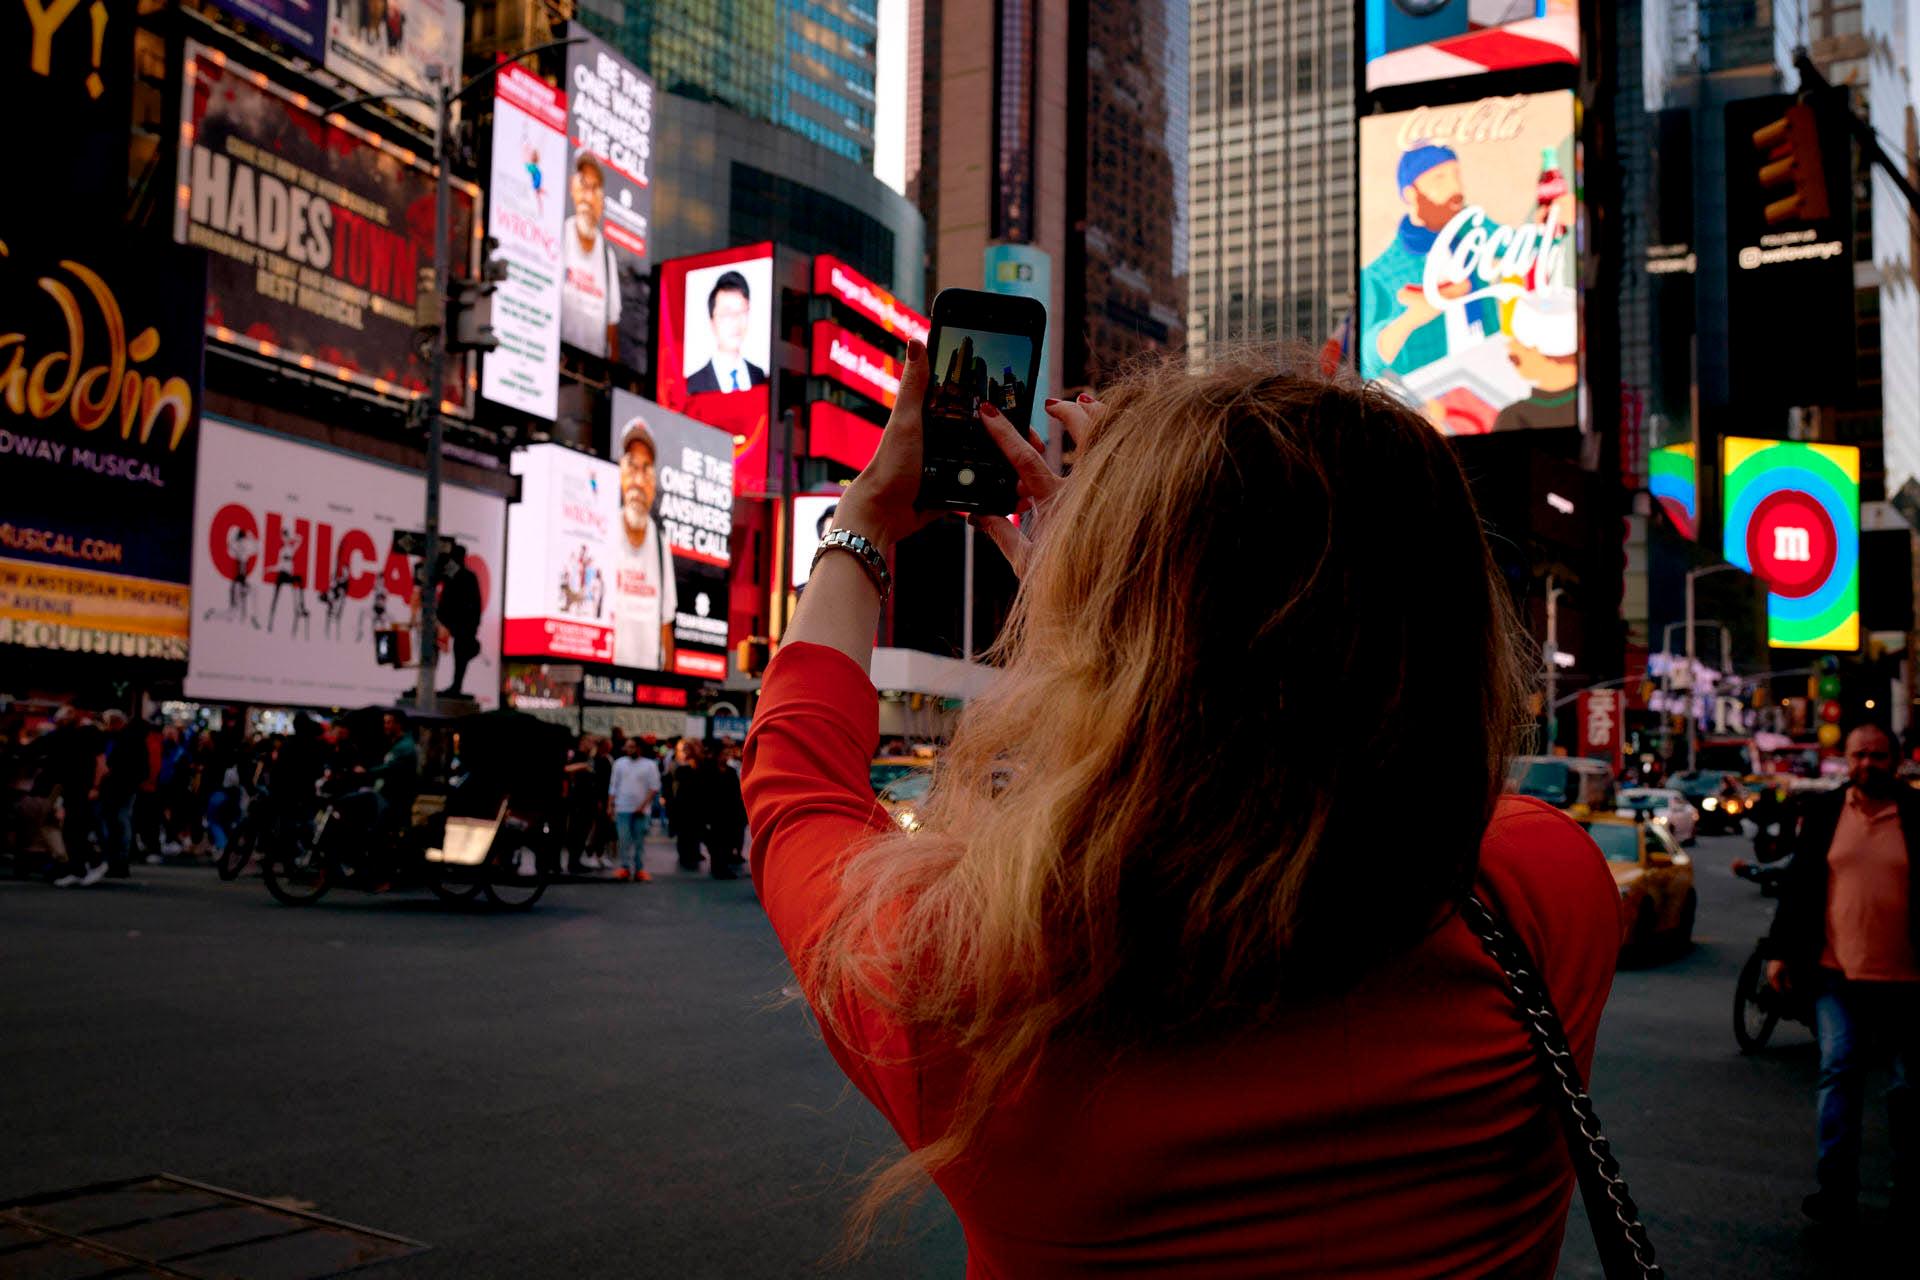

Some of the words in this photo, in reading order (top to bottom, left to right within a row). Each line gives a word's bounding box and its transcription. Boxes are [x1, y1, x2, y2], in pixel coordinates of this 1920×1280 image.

[574, 64, 611, 105] ONE
[611, 87, 651, 133] WHO
[597, 52, 620, 88] BE
[621, 68, 652, 110] THE
[573, 92, 650, 159] ANSWERS
[576, 118, 610, 160] THE
[609, 141, 648, 185] CALL
[72, 447, 165, 487] MUSICAL
[661, 465, 695, 498] ONE
[695, 479, 733, 511] WHO
[682, 447, 703, 475] BE
[704, 454, 733, 488] THE
[660, 492, 732, 536] ANSWERS
[208, 502, 491, 614] CHICA
[662, 520, 694, 550] THE
[694, 528, 731, 561] CALL
[1773, 526, 1811, 562] m
